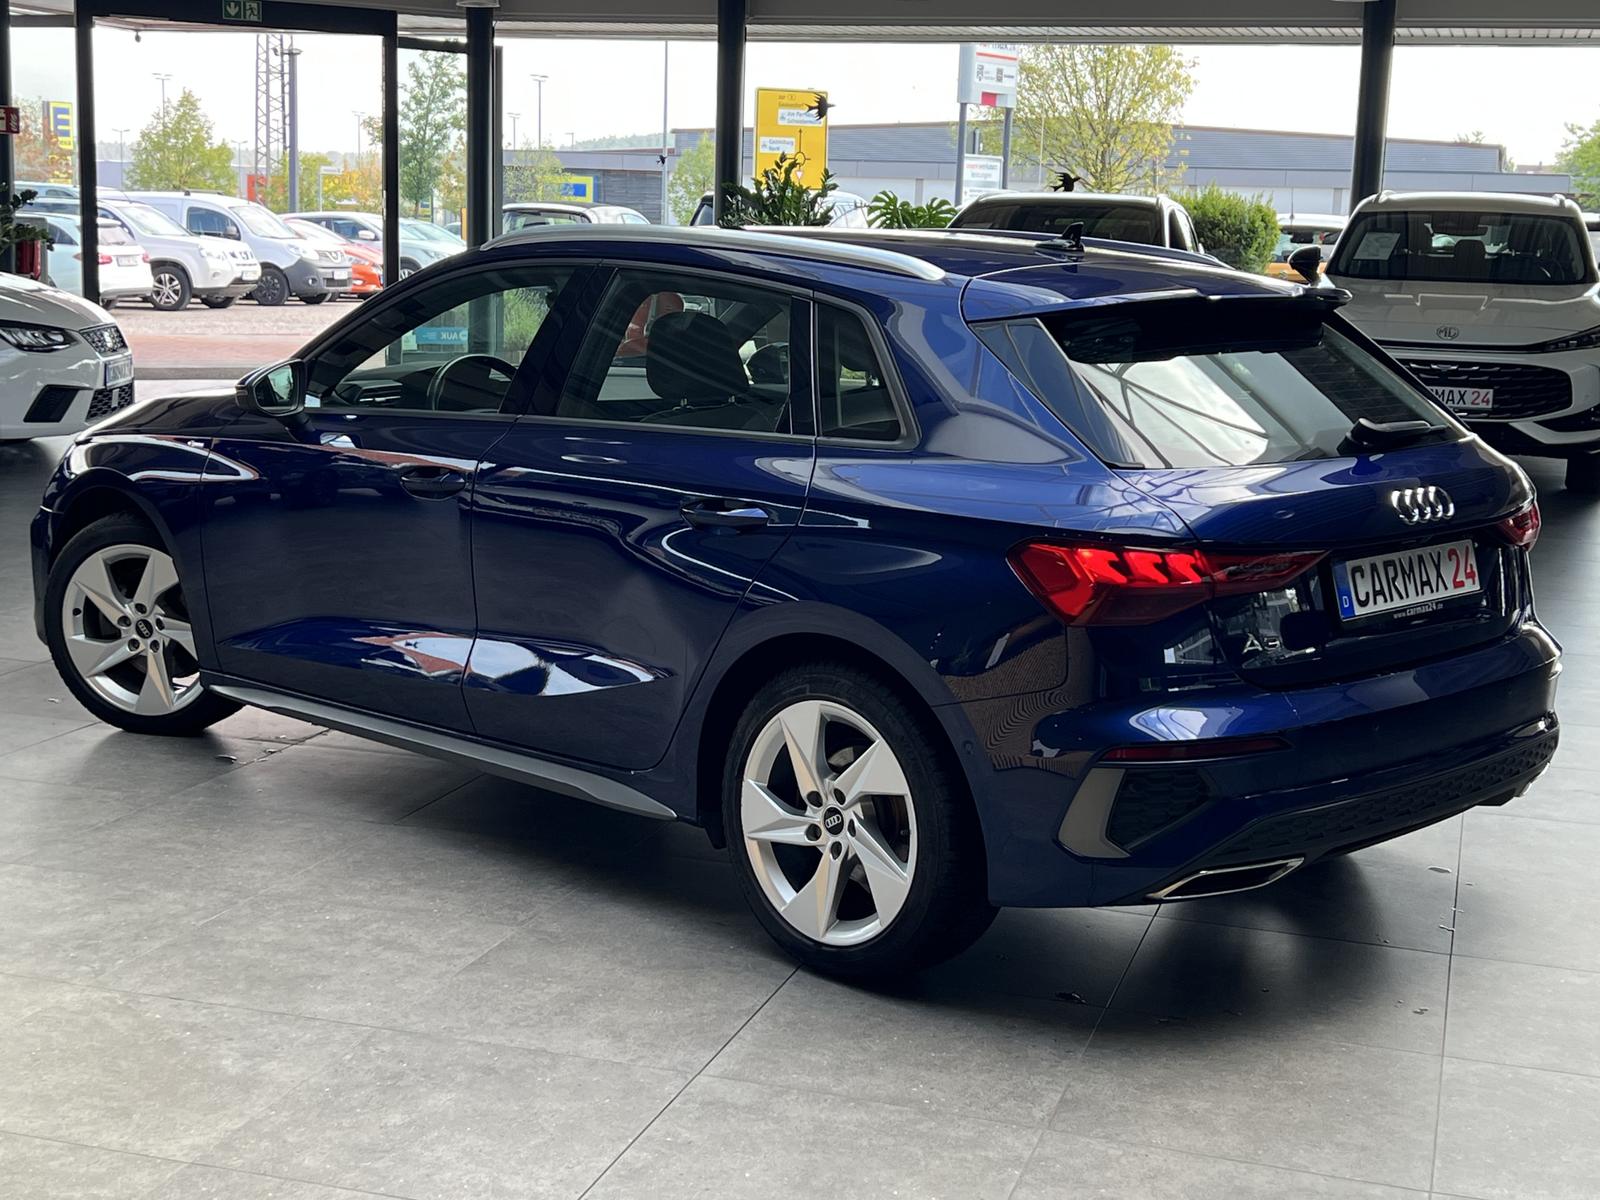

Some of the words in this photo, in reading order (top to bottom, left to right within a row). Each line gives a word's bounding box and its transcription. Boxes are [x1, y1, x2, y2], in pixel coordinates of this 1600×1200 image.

[53, 107, 70, 137] E
[1431, 388, 1467, 405] MAX
[1471, 390, 1490, 406] 24
[1351, 551, 1448, 608] CARMAX
[1448, 546, 1476, 589] 24
[1342, 595, 1350, 609] D
[1393, 600, 1444, 619] www.carmax24.de
